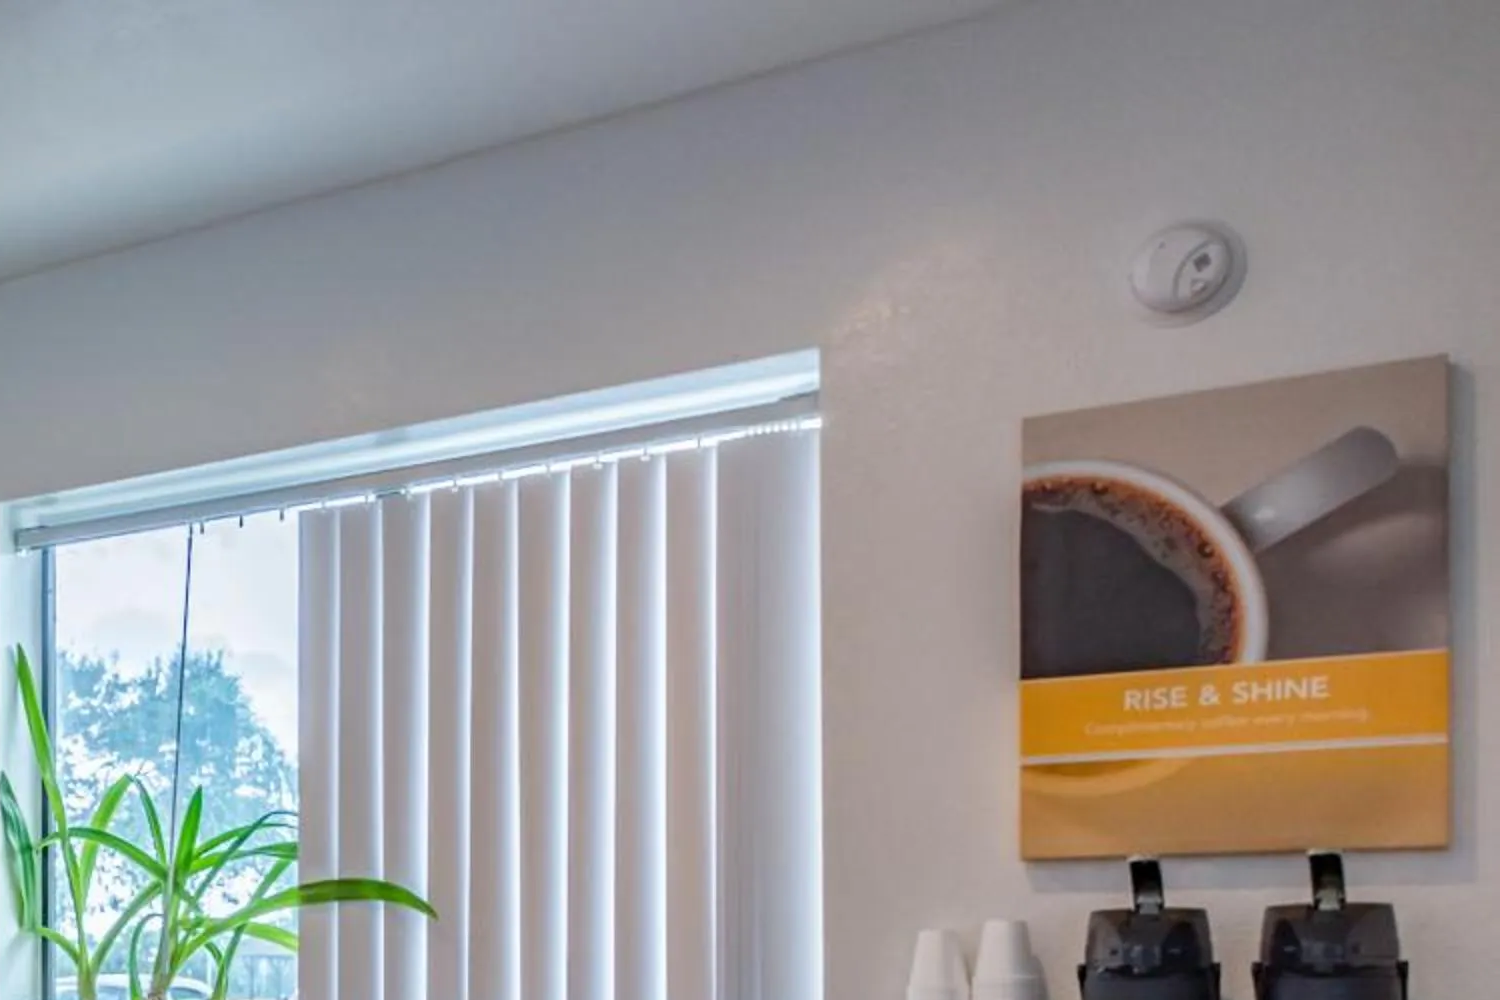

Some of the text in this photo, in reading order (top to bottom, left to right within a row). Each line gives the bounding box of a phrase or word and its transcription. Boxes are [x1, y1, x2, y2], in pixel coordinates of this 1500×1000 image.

[1123, 675, 1331, 711] RISE & SHINE
